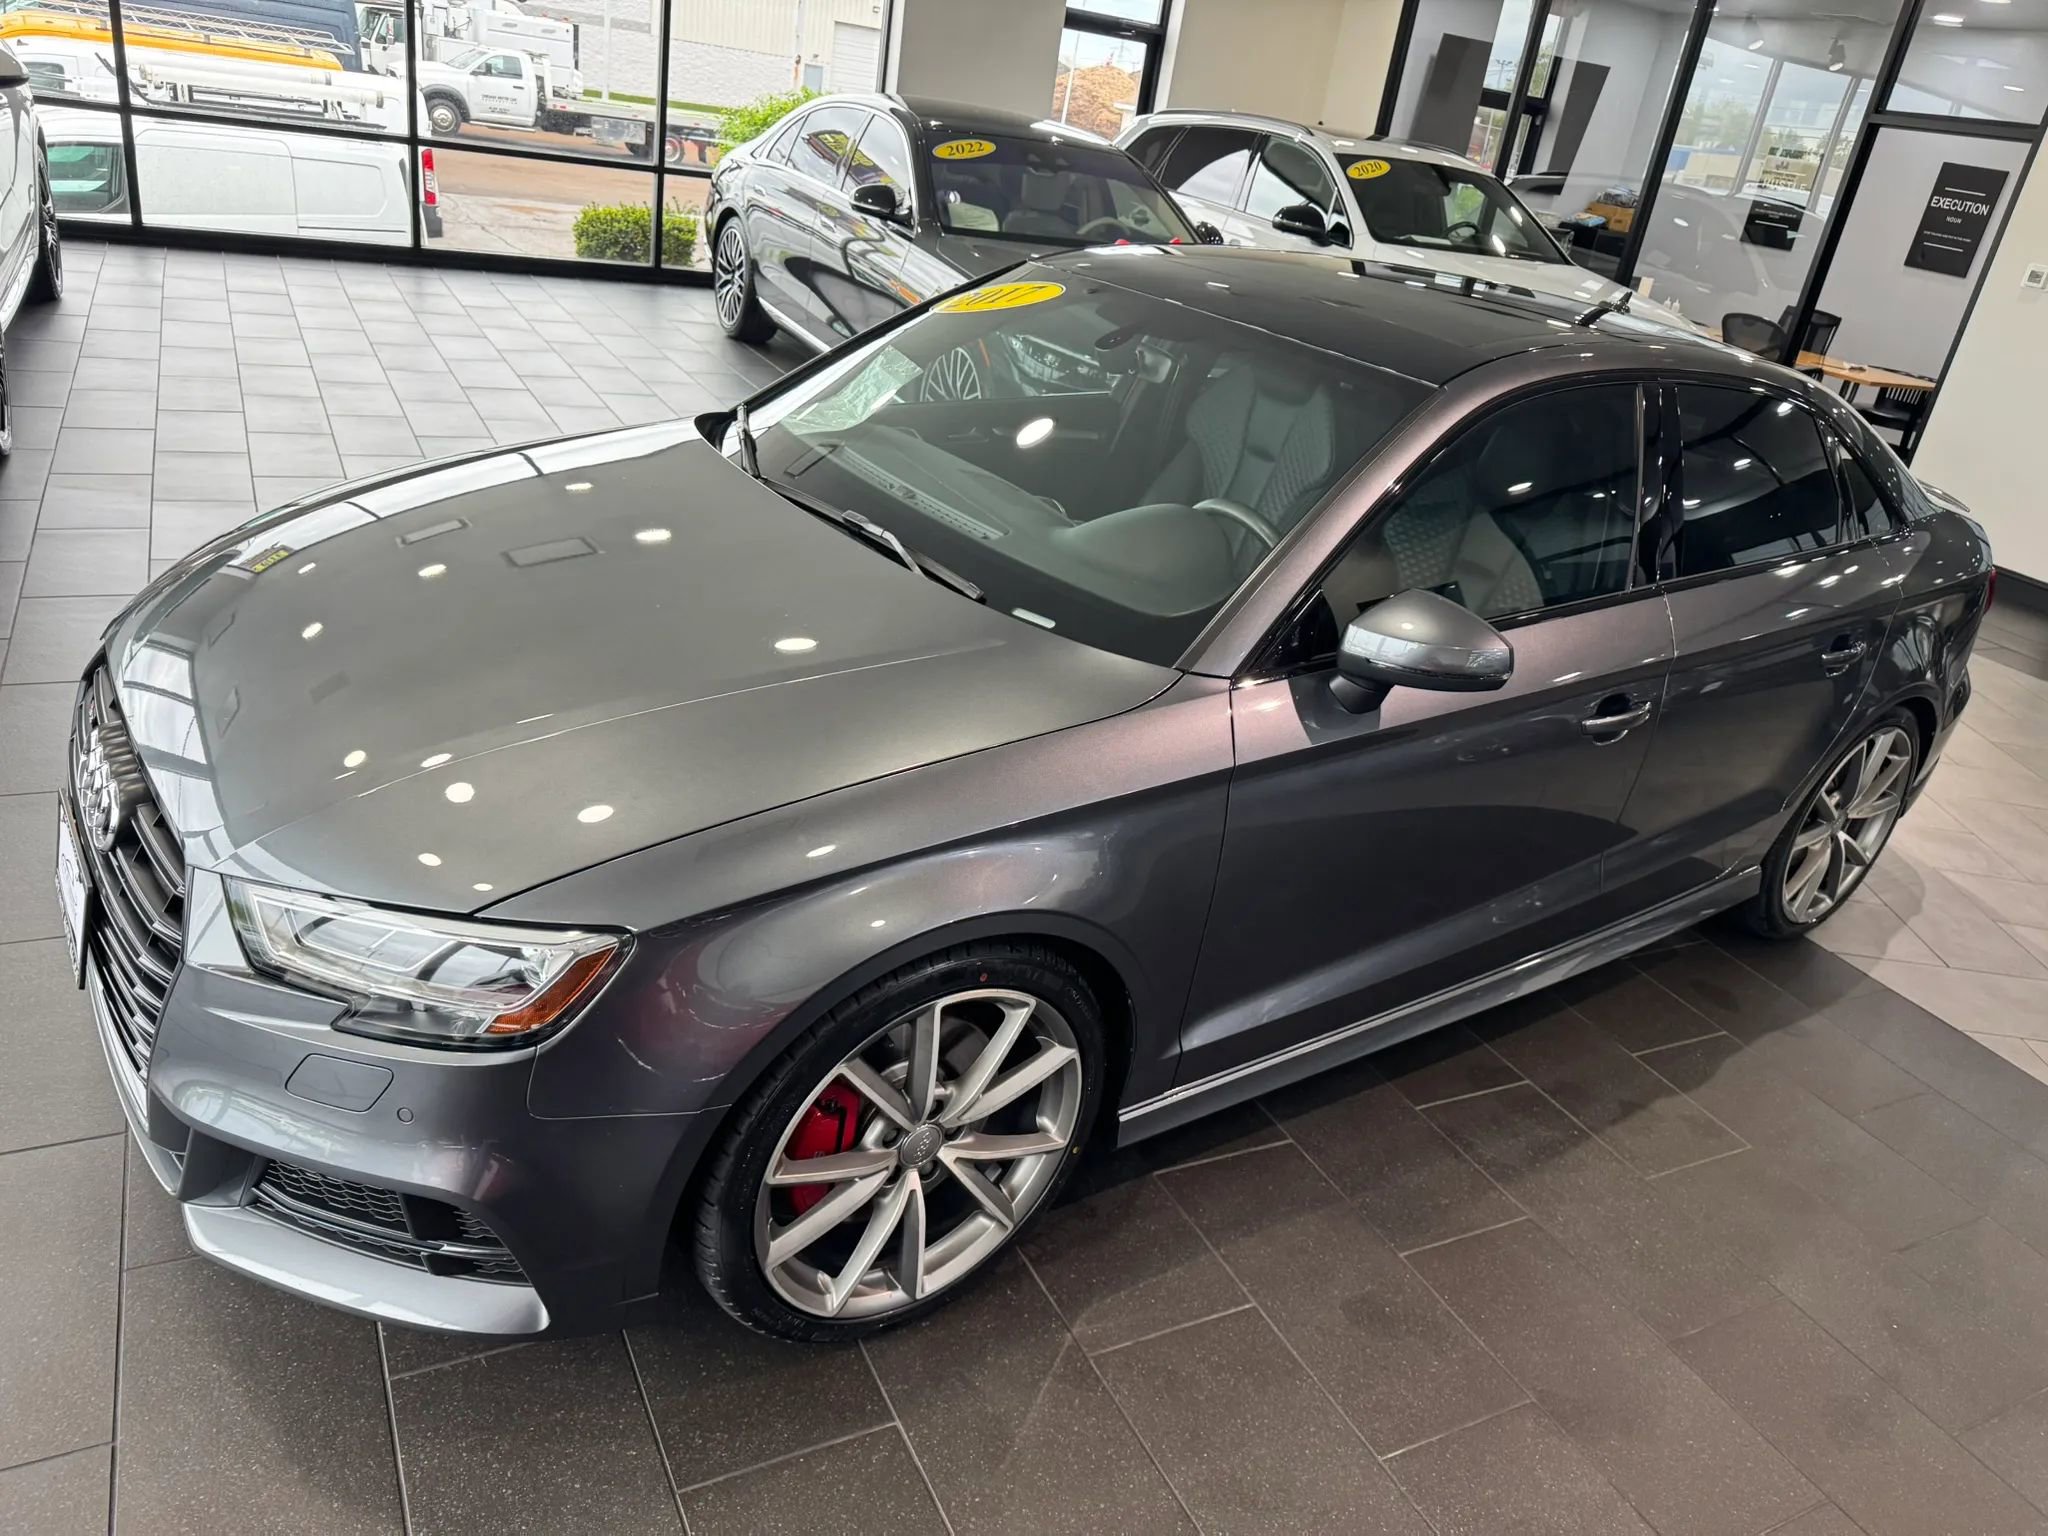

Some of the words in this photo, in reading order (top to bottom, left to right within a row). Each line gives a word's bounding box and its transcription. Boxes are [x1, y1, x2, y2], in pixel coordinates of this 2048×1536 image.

[946, 141, 985, 156] 2022
[1354, 161, 1382, 176] 2020
[1930, 196, 1990, 216] EXECUTION
[1946, 216, 1962, 224] NOUN
